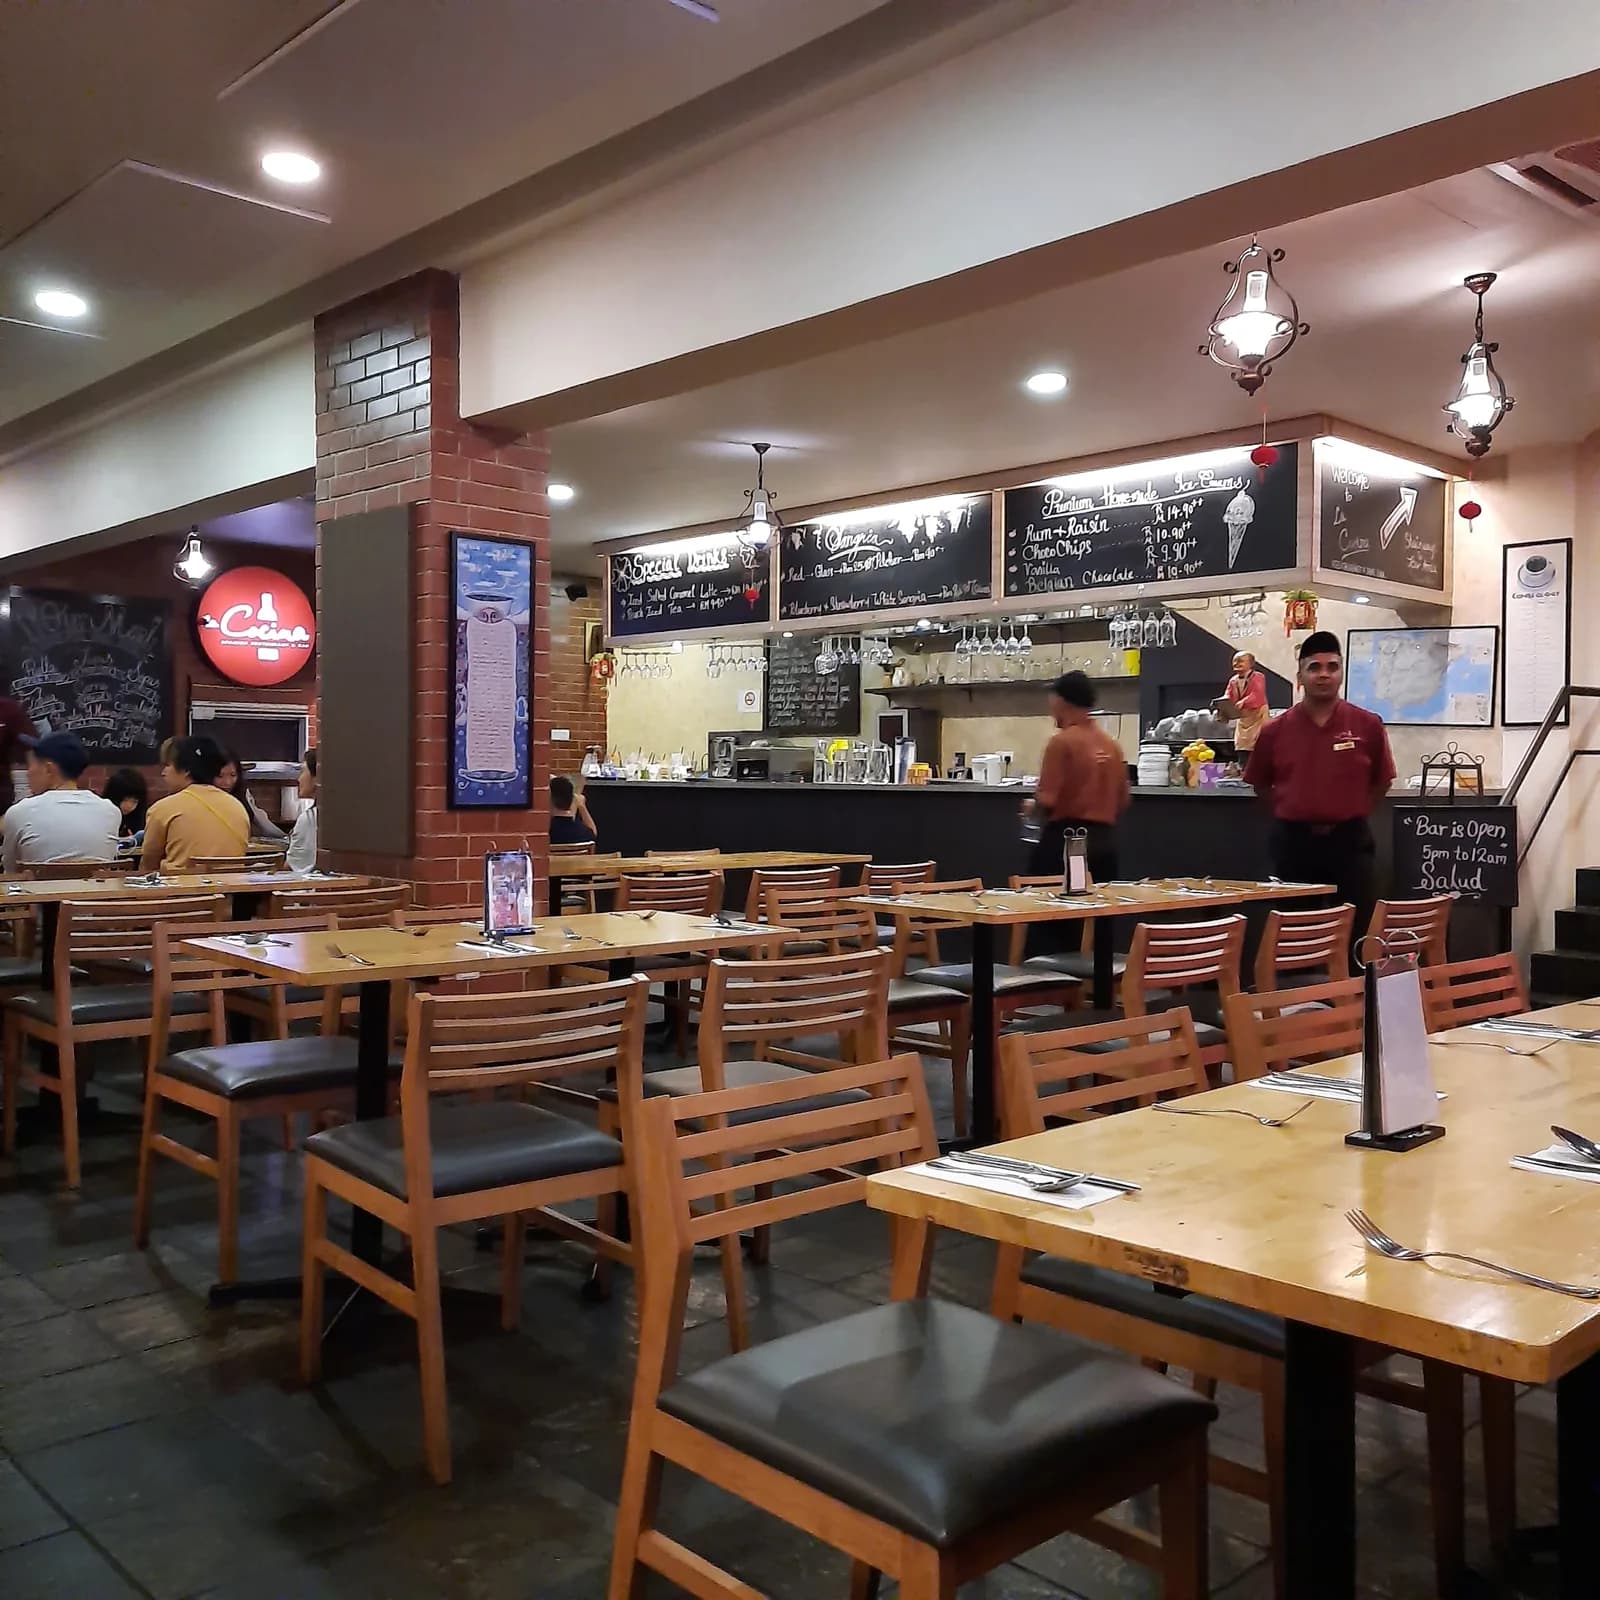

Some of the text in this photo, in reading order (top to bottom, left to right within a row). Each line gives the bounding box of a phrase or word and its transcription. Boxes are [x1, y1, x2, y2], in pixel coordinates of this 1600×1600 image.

[1331, 465, 1369, 491] Welcome
[1345, 488, 1352, 502] to
[1056, 539, 1092, 560] Chips
[633, 554, 680, 581] Special
[815, 564, 833, 578] Glass
[1023, 561, 1060, 576] Vanilla
[1025, 576, 1074, 592] Belgian
[1083, 567, 1134, 585] Chocolate
[668, 600, 682, 614] Tea
[220, 603, 310, 642] Cocina
[1450, 821, 1464, 838] is
[1423, 845, 1507, 864] 5pm to 12am
[1412, 861, 1488, 891] Salud
